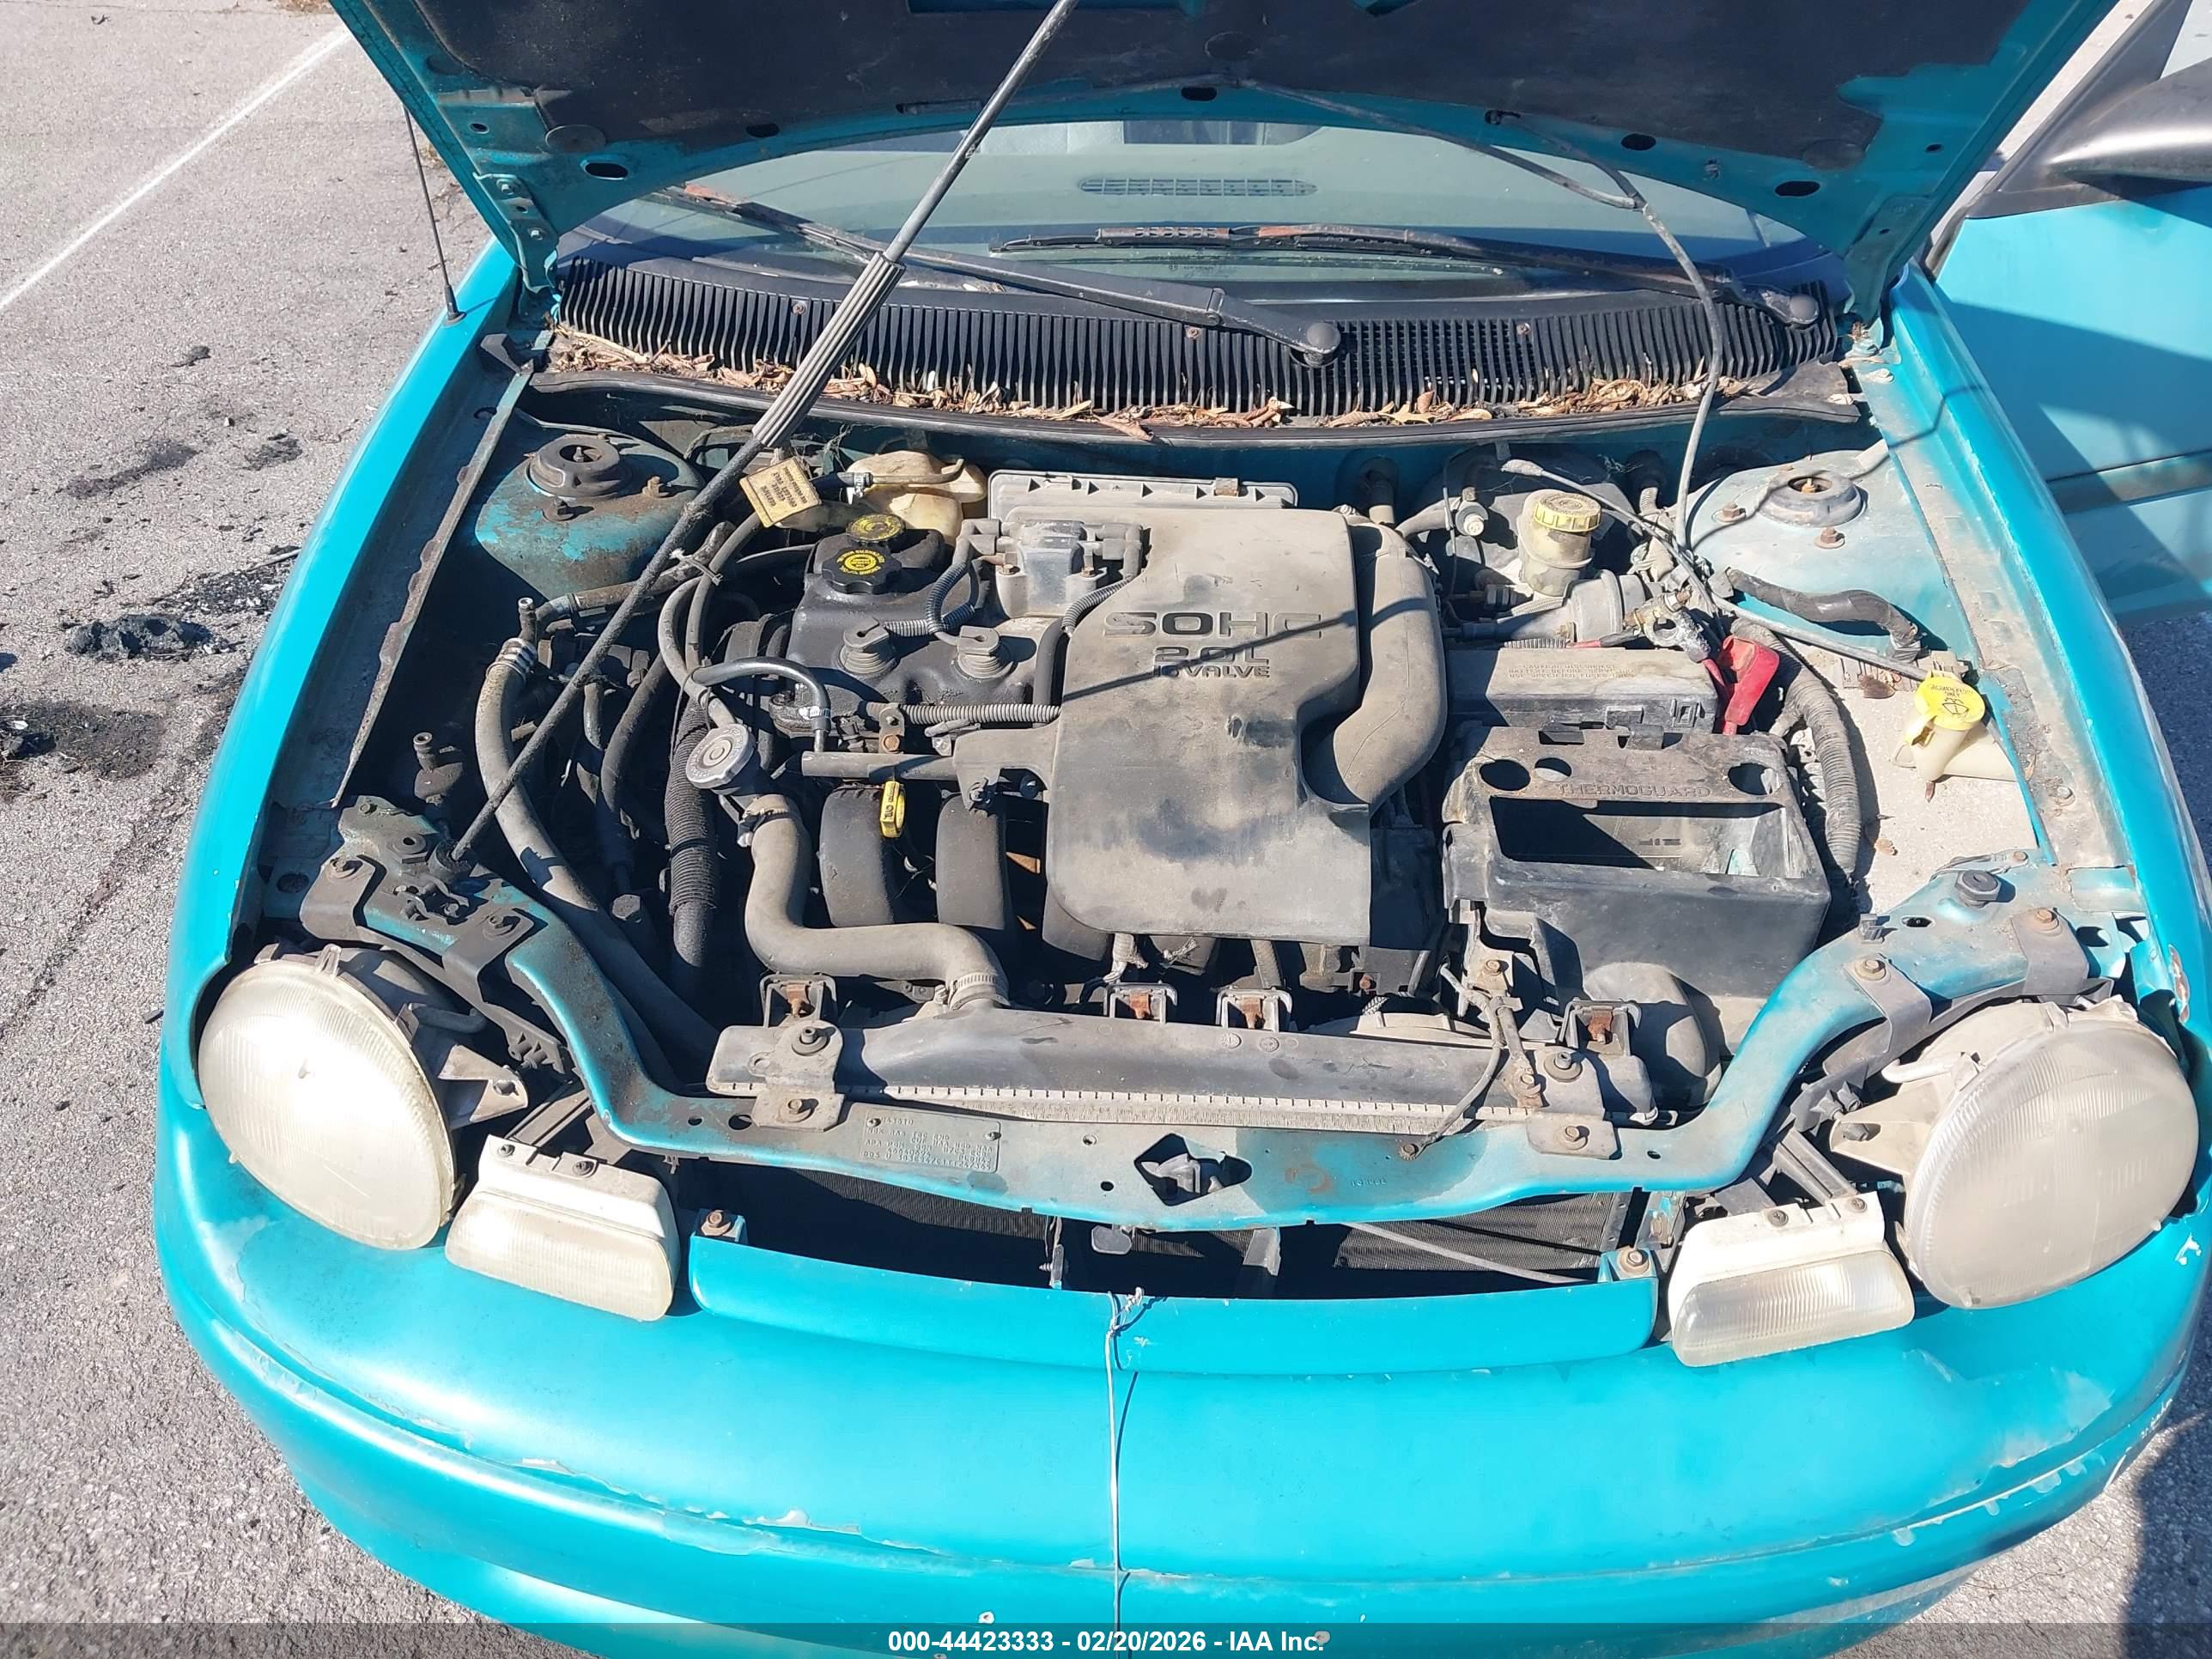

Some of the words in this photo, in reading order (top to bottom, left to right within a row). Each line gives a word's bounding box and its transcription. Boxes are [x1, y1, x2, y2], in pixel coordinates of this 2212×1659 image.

[1103, 611, 1322, 639] SOHC
[1153, 646, 1270, 665] 2.0L
[1185, 665, 1271, 678] VALVE
[1559, 782, 1711, 798] THERMOGUARD
